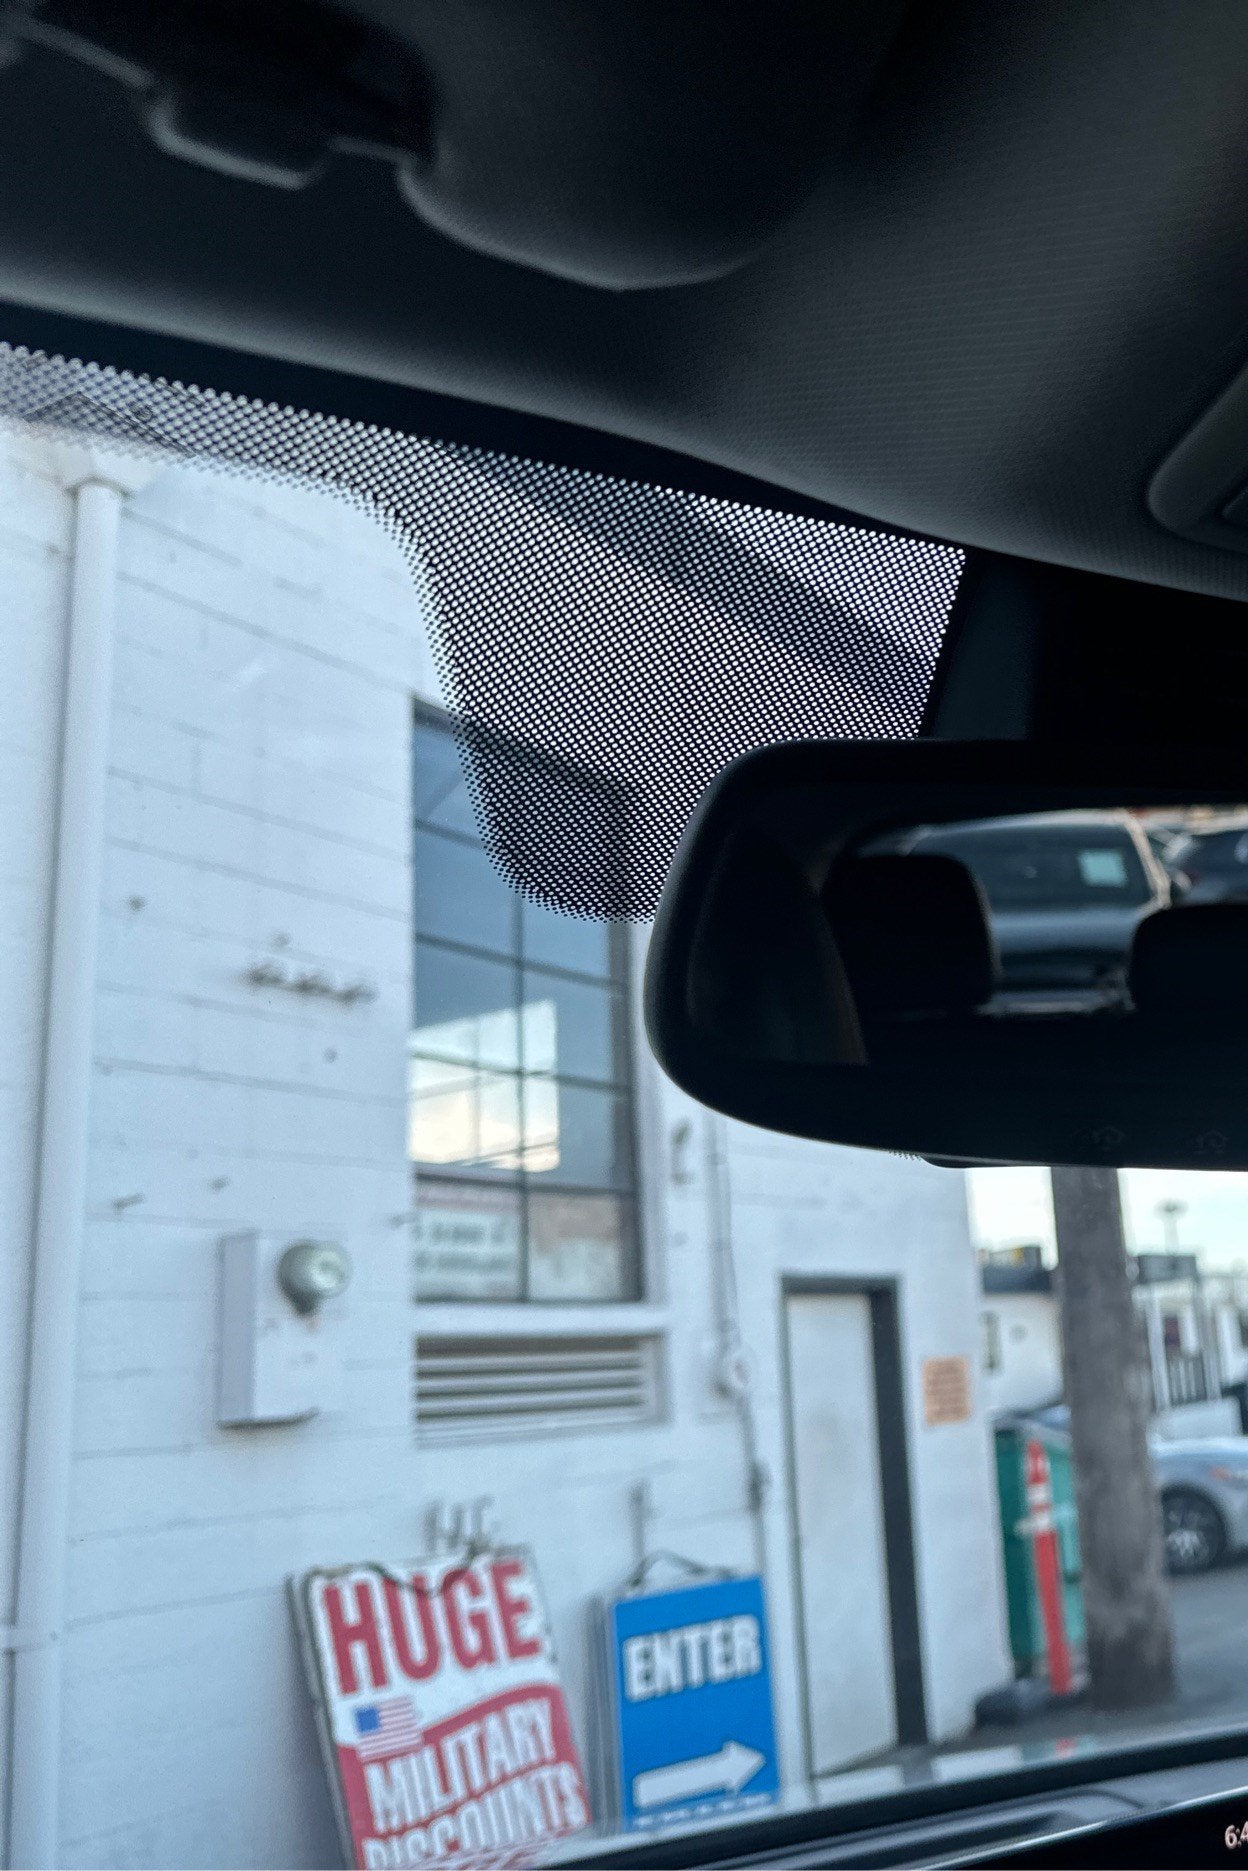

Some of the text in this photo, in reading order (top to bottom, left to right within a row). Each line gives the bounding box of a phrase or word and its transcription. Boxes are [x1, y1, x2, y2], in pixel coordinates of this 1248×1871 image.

[322, 1559, 542, 1696] HUGE
[622, 1613, 763, 1702] ENTER
[364, 1702, 556, 1834] MILITARY
